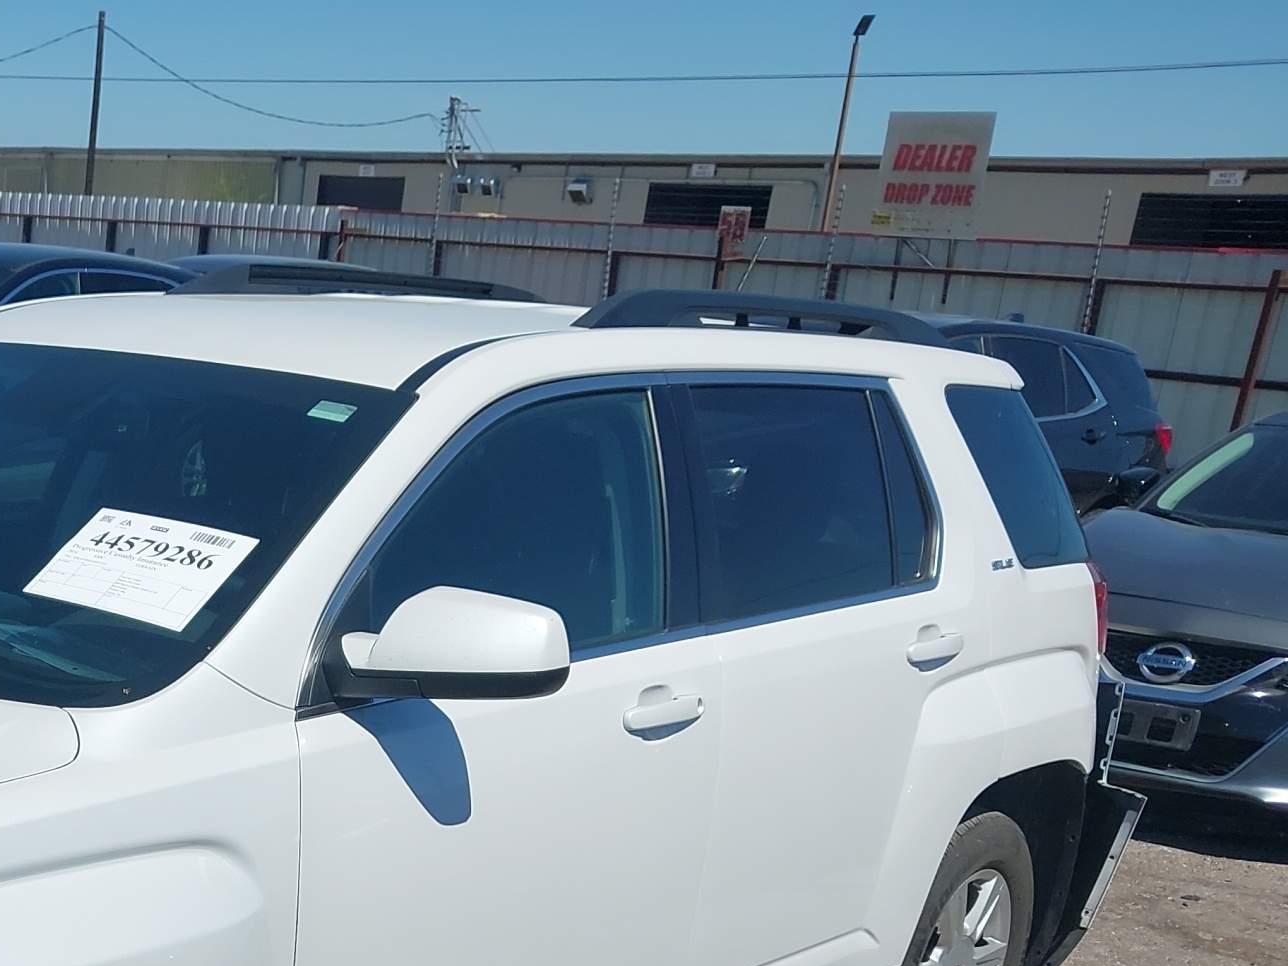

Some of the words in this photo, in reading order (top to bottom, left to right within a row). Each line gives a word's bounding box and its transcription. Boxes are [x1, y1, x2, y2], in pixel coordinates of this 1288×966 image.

[892, 143, 977, 173] DEALER
[883, 182, 930, 205] DROP
[930, 184, 976, 207] ZONE
[90, 530, 223, 571] 44579286
[991, 558, 1015, 571] SLE
[1141, 654, 1186, 669] NISSAN
